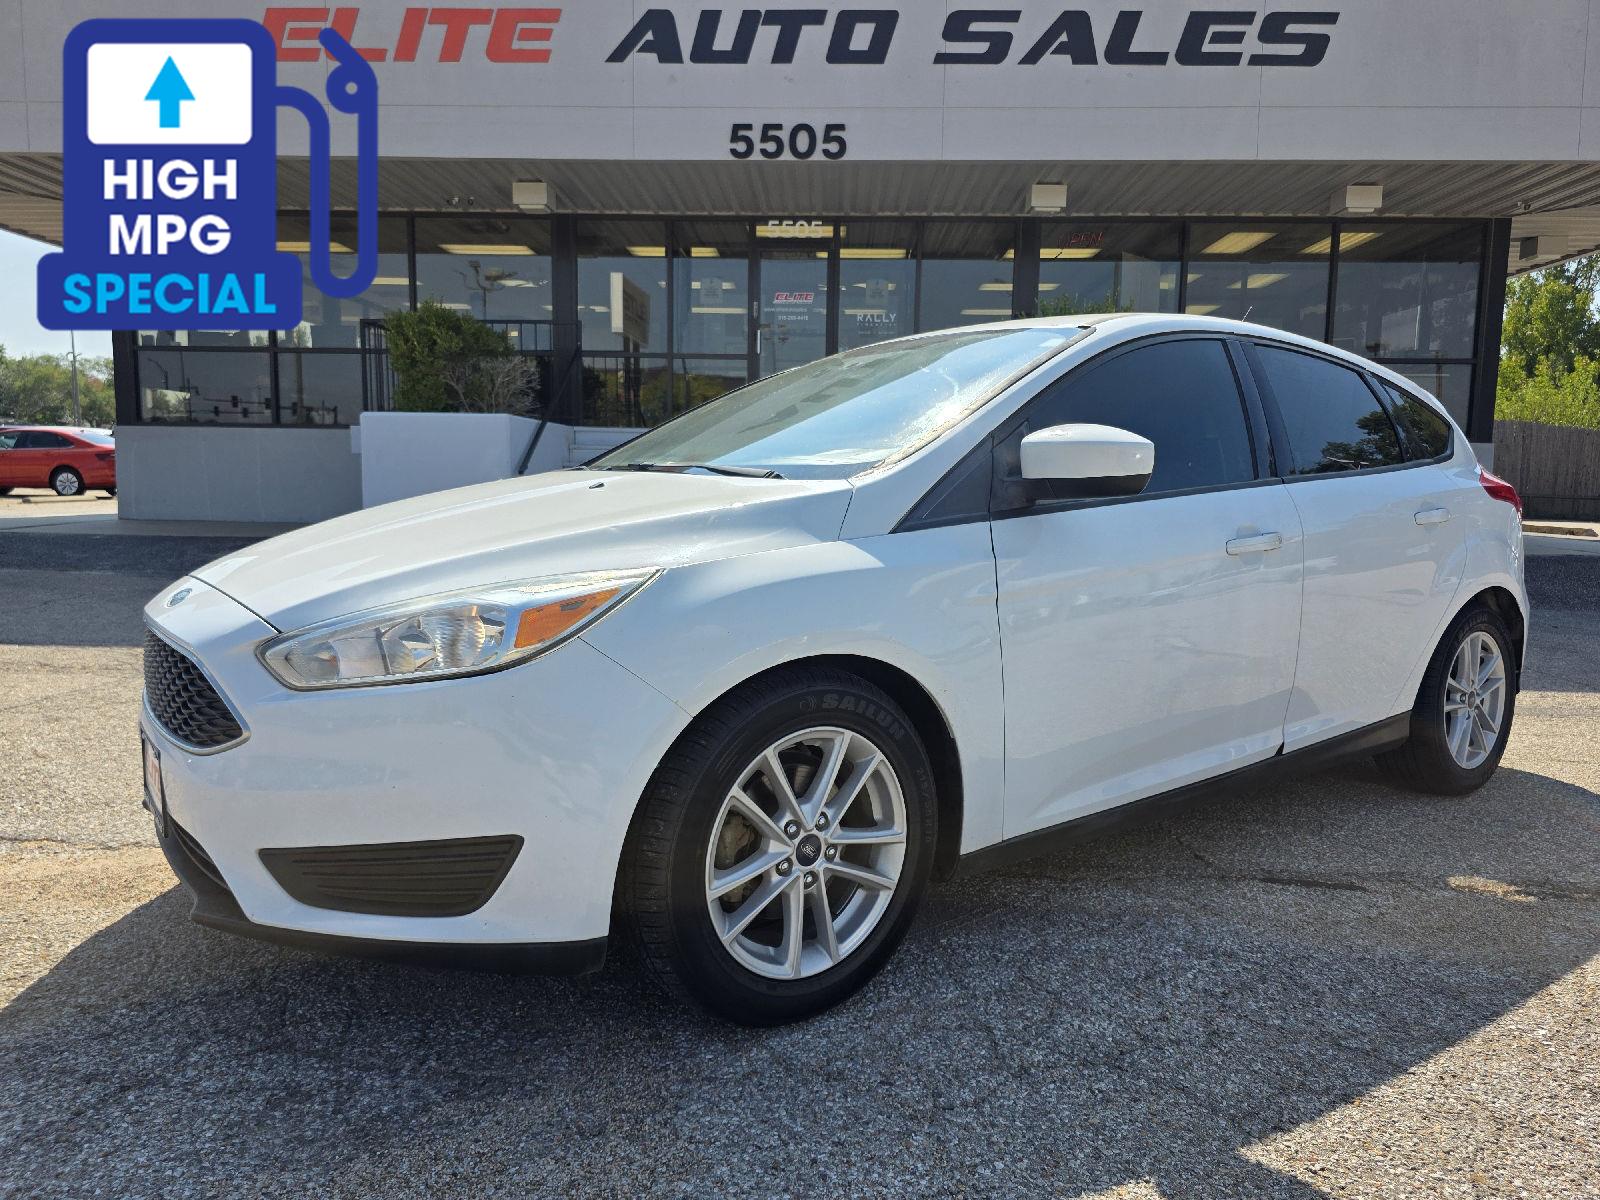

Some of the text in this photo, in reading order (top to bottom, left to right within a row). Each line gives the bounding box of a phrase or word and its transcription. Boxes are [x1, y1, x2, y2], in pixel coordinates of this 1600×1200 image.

[263, 8, 1340, 67] ELITE AUTO SALES
[729, 123, 848, 160] 5505
[767, 220, 823, 238] 5505
[774, 292, 814, 302] ELITE
[856, 313, 896, 322] RALLY
[822, 693, 905, 740] SAILUN
